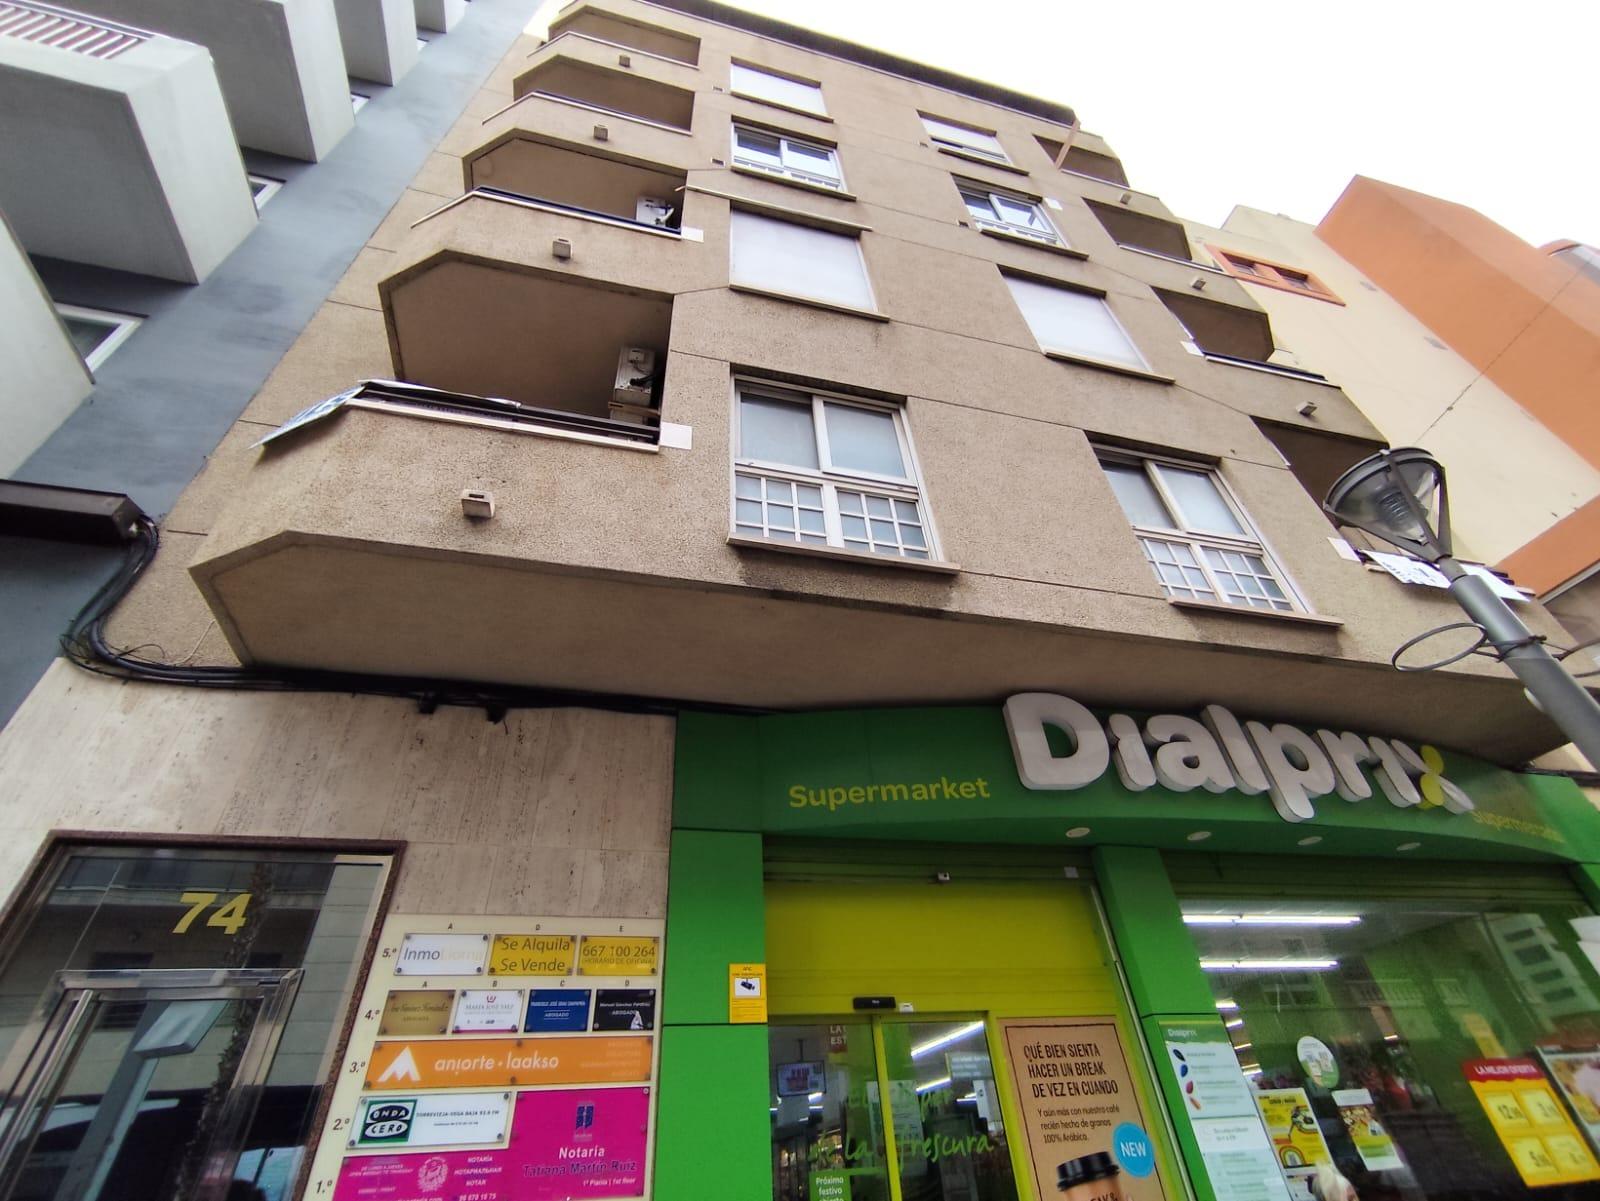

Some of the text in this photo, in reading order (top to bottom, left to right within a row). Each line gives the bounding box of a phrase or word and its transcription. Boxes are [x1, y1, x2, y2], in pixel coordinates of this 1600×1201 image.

[1003, 692, 1475, 823] Dialprix
[789, 776, 991, 812] Supermarket
[172, 892, 253, 935] 74
[501, 937, 570, 953] Se Alquila
[582, 945, 656, 957] 667 100 264
[500, 958, 566, 972] Se Vende
[1023, 1041, 1101, 1060] QUÉ BIEN SIENTA
[506, 1050, 560, 1070] laakso
[1027, 1061, 1106, 1079] HACER UN BREAK
[1031, 1079, 1119, 1098] DE VEZ EN CUANDO
[372, 1108, 407, 1120] ONDA
[1070, 1106, 1082, 1116] con
[1082, 1104, 1107, 1115] nuestro
[370, 1122, 404, 1135] CERO
[1040, 1120, 1060, 1130] recién
[1060, 1119, 1080, 1129] hecho
[1080, 1118, 1089, 1128] de
[1043, 1134, 1062, 1144] 100%
[558, 1144, 605, 1160] Notaría
[1119, 1141, 1147, 1157] NEW
[524, 1160, 637, 1177] Tatiana Martín Ruiz
[815, 1176, 844, 1186] Próximo
[818, 1186, 843, 1197] festivo
